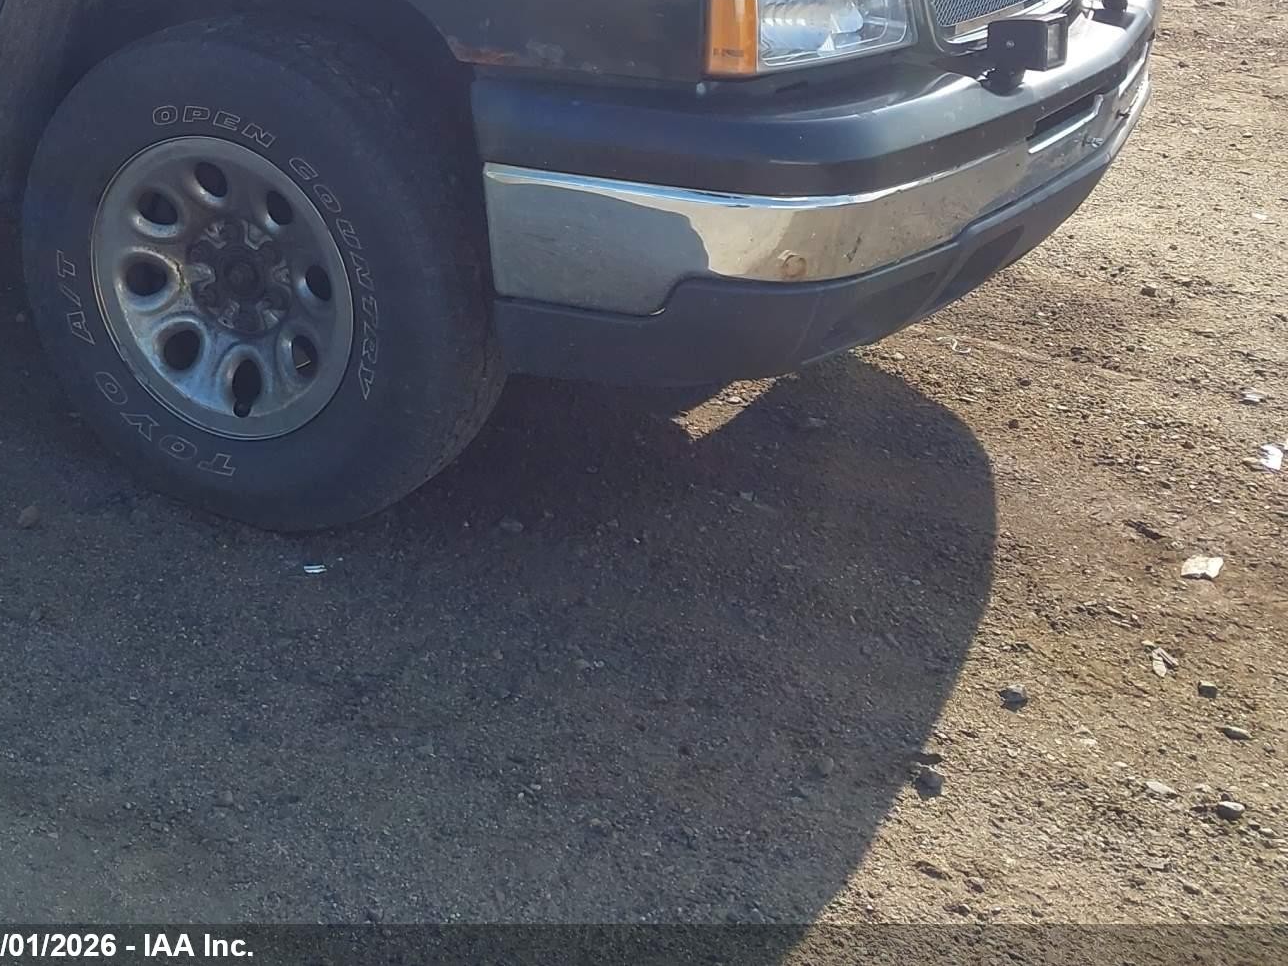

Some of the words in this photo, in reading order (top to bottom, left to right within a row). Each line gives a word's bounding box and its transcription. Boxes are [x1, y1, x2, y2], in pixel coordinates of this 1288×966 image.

[56, 249, 96, 346] A/T
[152, 105, 276, 148] OPEN
[289, 157, 378, 400] COUNTRY
[95, 371, 237, 476] TOYO
